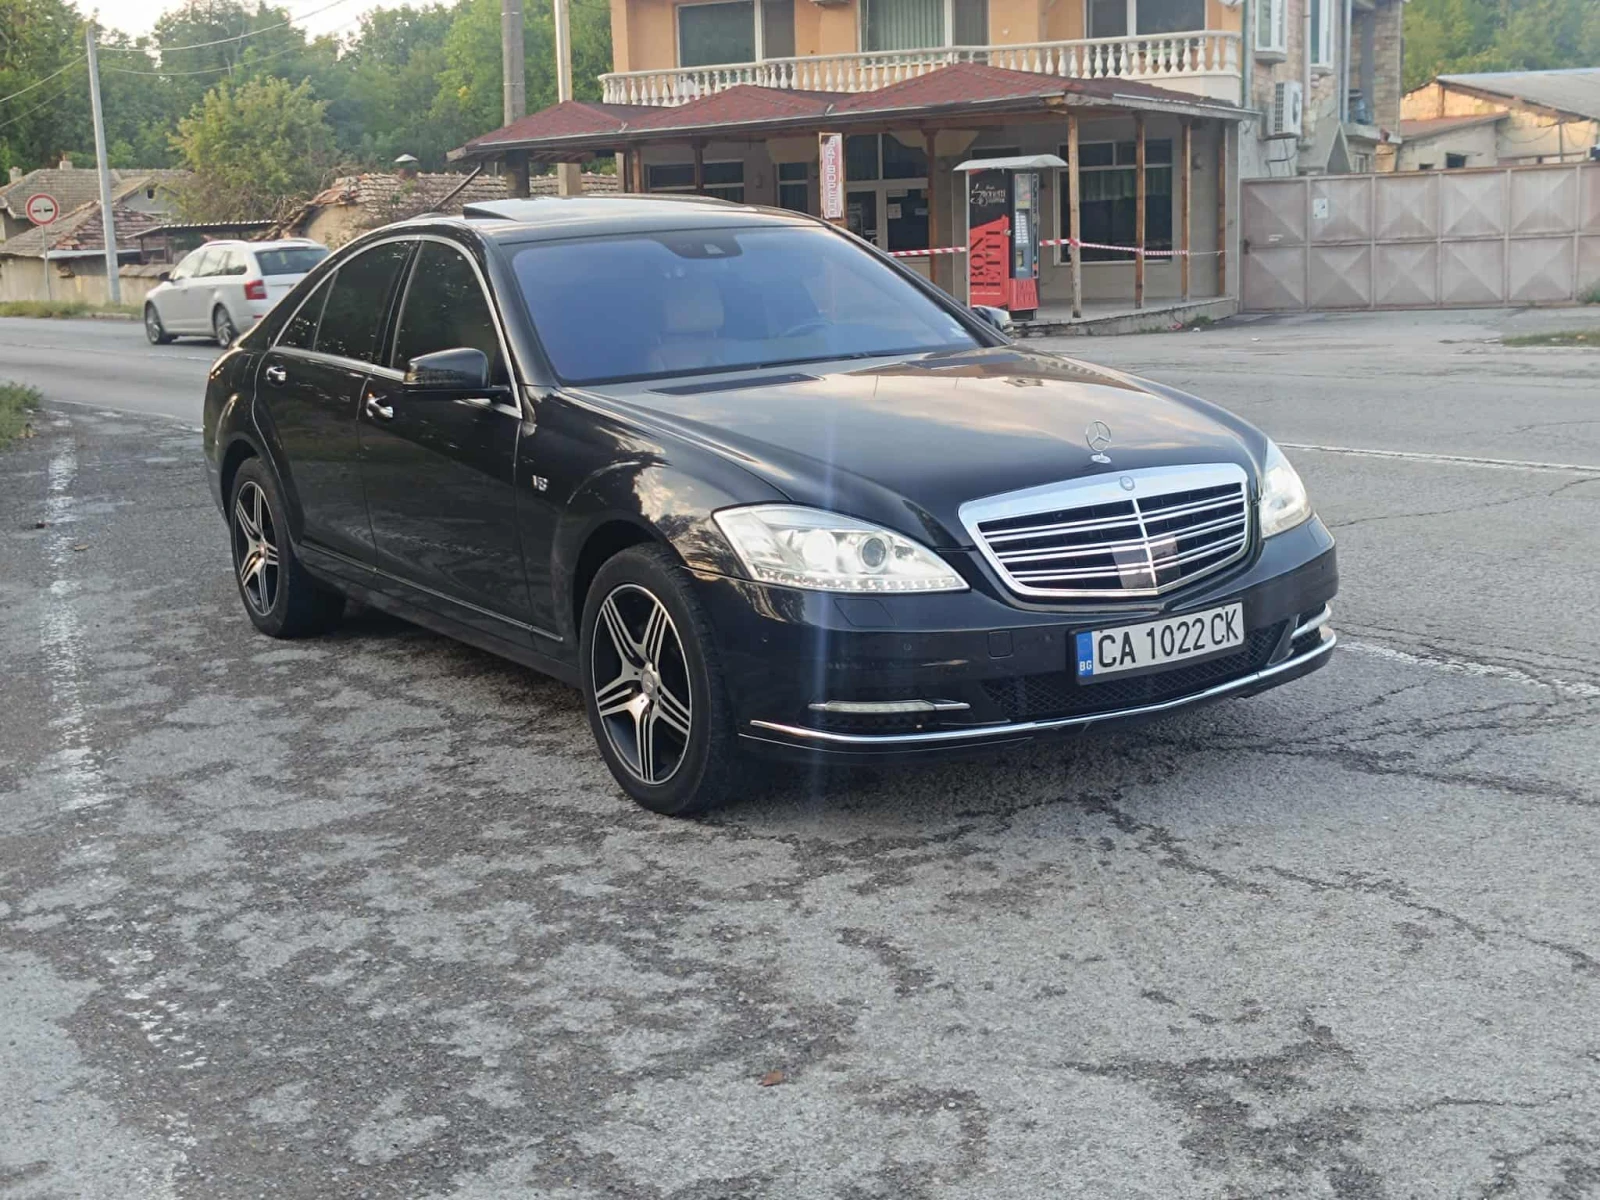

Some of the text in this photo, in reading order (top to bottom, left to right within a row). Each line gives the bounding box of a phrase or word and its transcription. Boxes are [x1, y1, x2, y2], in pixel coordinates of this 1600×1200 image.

[1098, 608, 1239, 668] CA 1022 CK
[1079, 660, 1093, 672] BG
